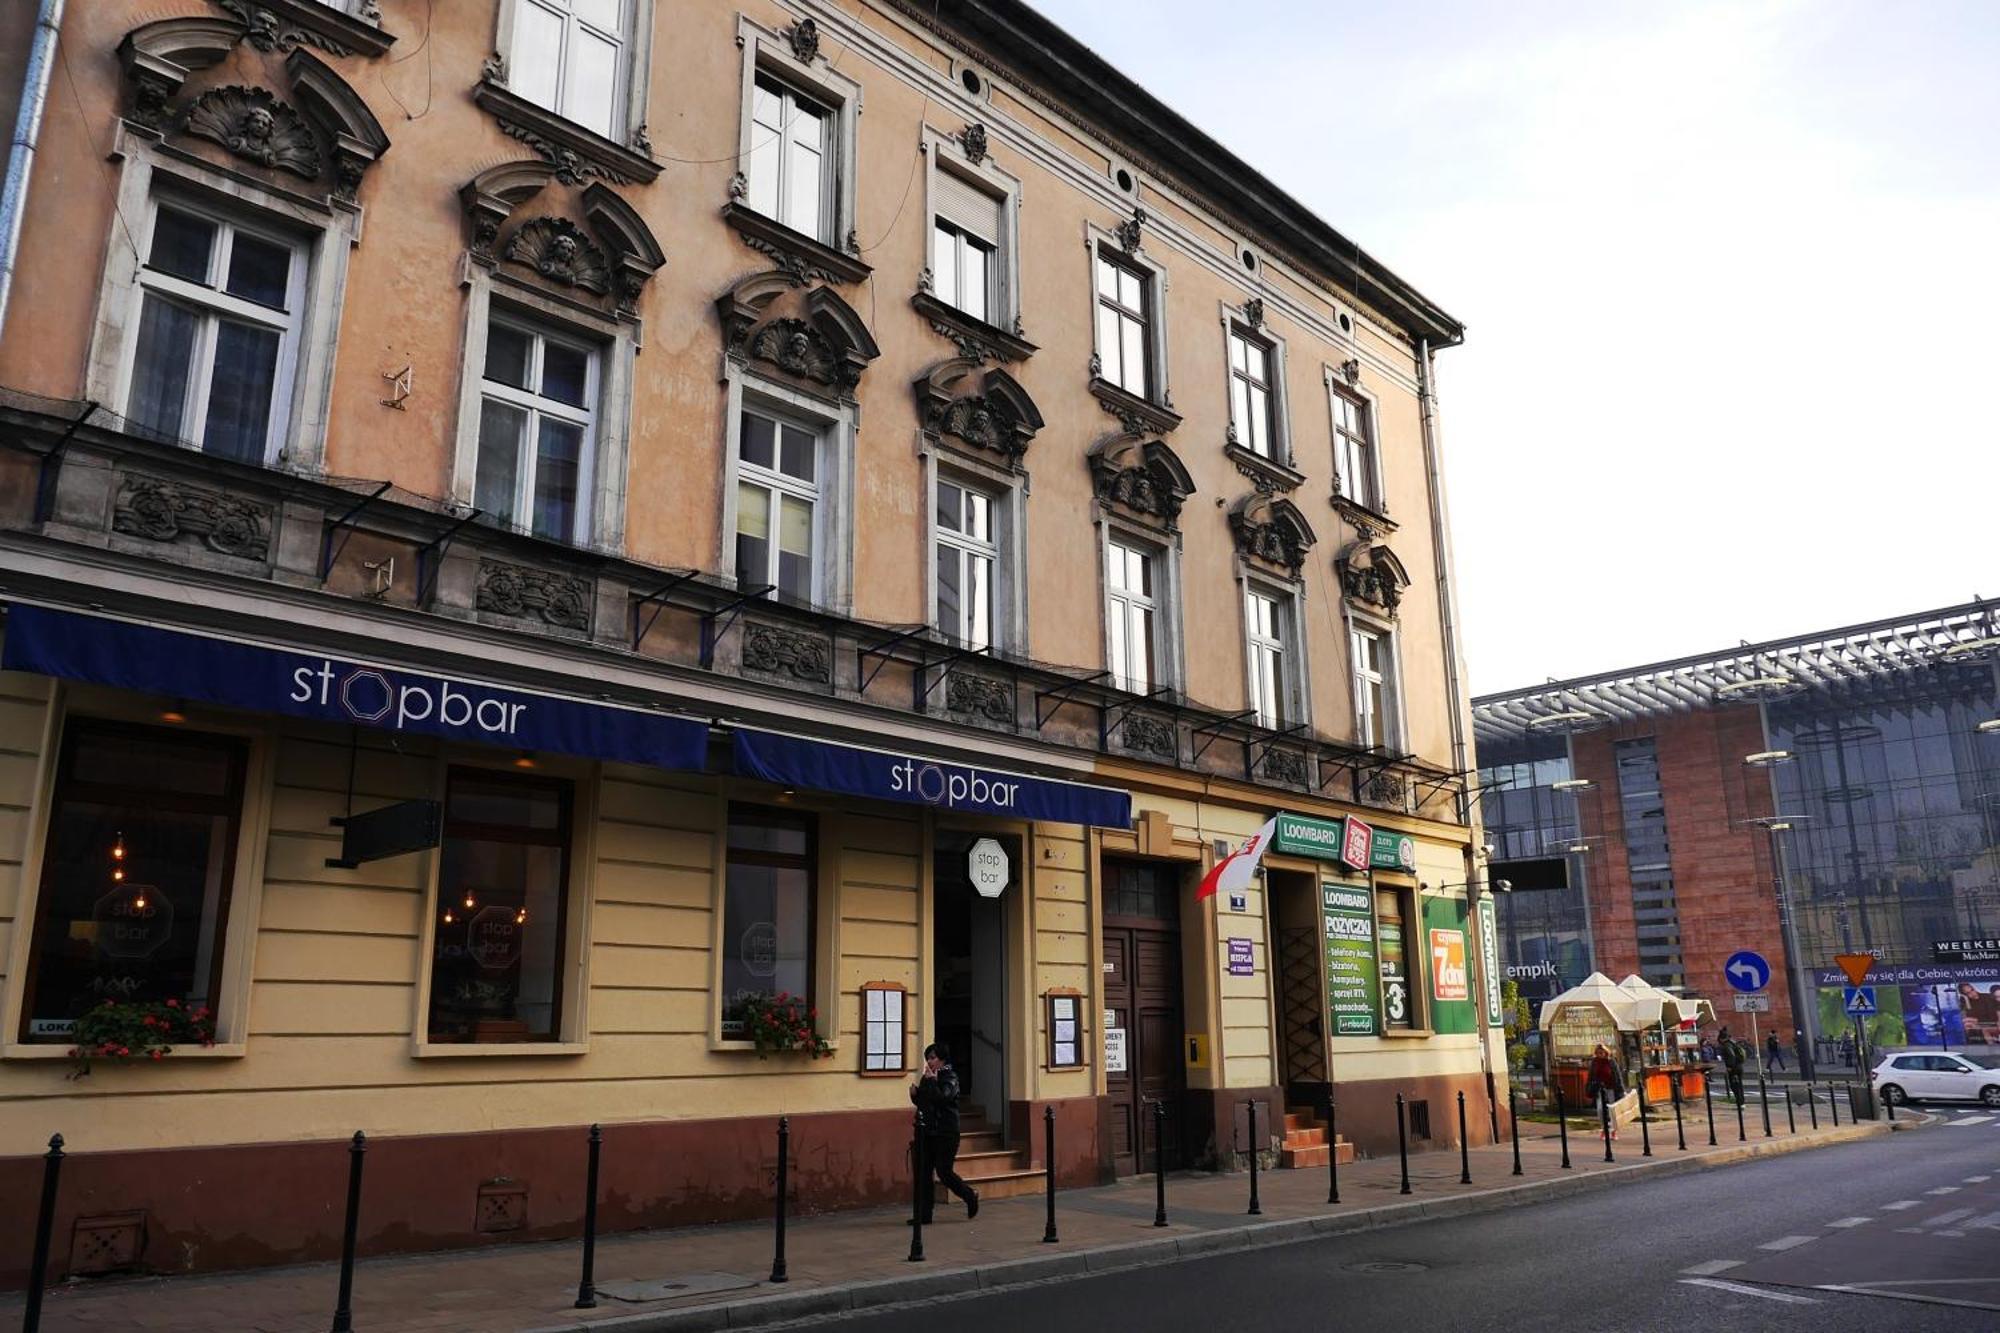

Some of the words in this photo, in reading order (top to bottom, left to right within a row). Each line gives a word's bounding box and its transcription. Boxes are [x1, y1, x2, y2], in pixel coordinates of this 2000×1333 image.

[1283, 822, 1336, 845] LOOMBARD
[978, 853, 1000, 867] stop
[980, 870, 999, 883] bar
[1324, 891, 1369, 908] LOOMBARD
[1936, 941, 2000, 951] WEEKE
[1482, 909, 1498, 1018] LOOMBARD
[1962, 952, 2000, 961] MaxMara
[1507, 959, 1558, 979] empik
[1879, 971, 1895, 982] się
[1898, 970, 1914, 980] dla
[1916, 967, 1953, 980] Ciebie,
[1955, 966, 1998, 978] wkrótce
